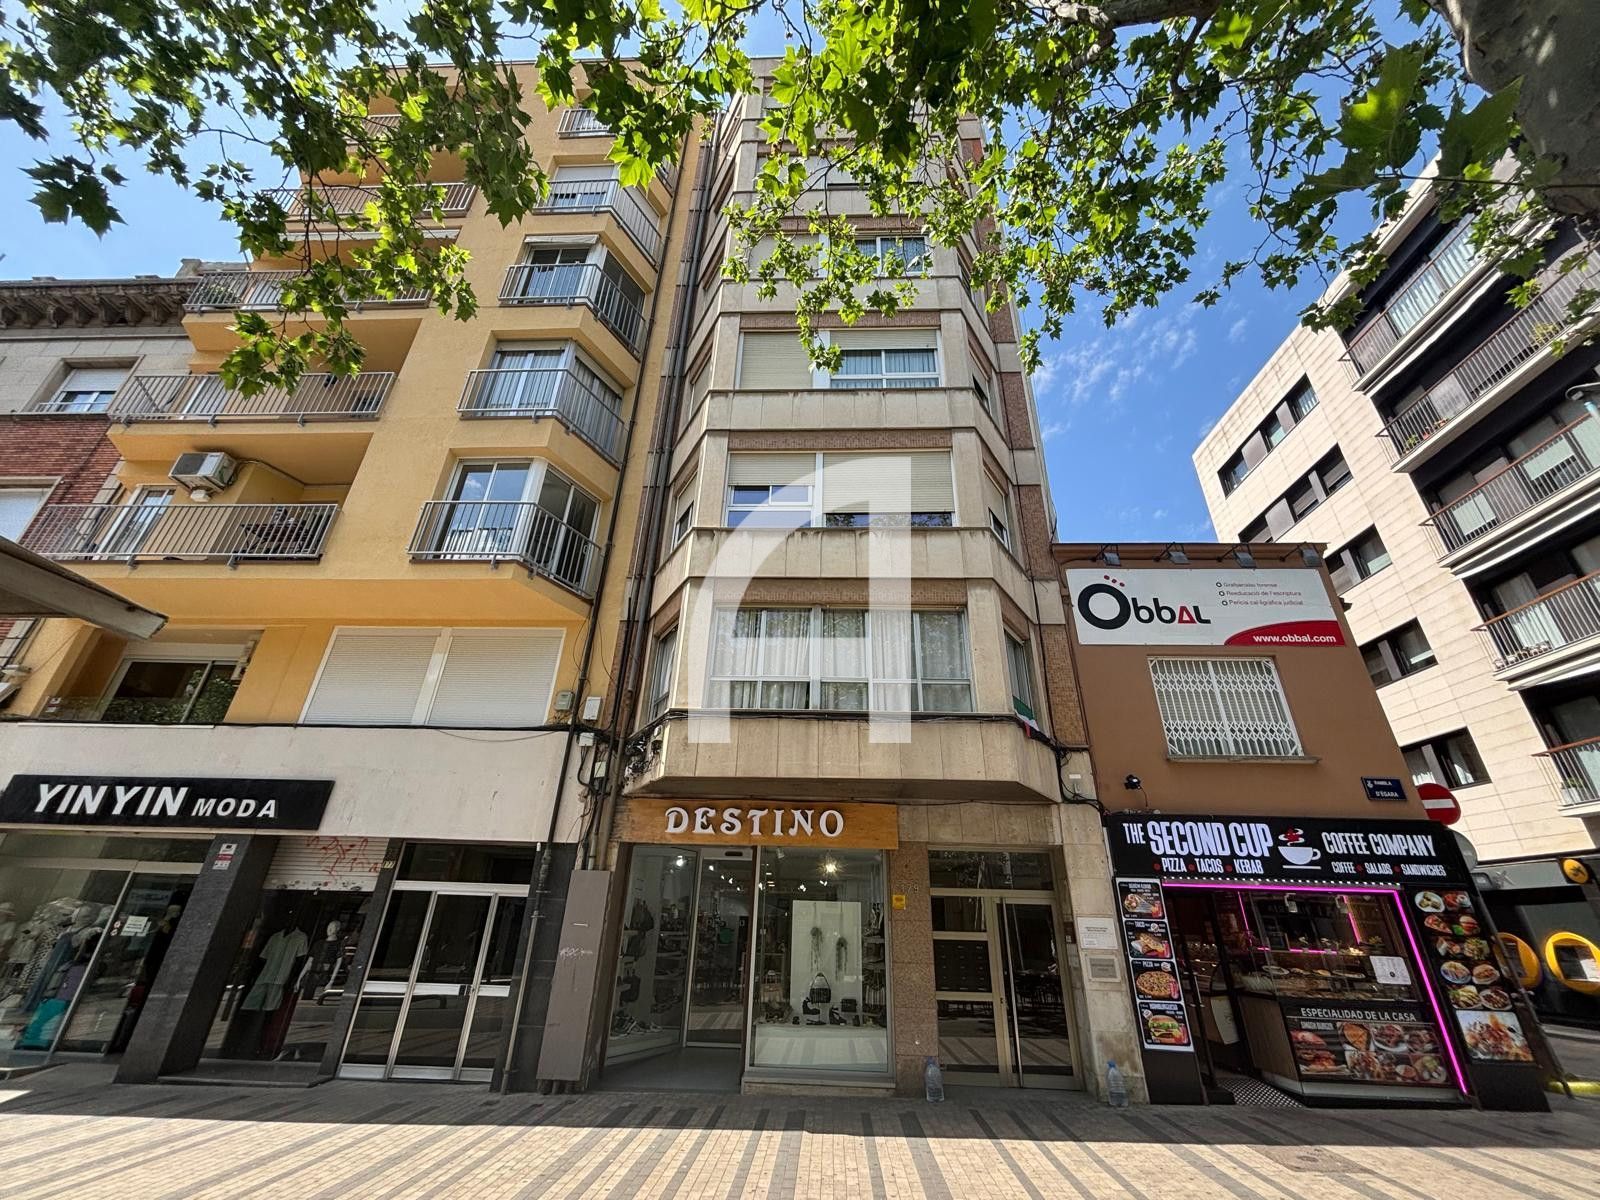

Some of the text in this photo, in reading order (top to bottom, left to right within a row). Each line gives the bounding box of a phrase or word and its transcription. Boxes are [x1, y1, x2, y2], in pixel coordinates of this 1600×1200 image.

[1253, 634, 1336, 642] www.obbal.com
[191, 797, 276, 818] MODA
[664, 806, 844, 838] DESTINO
[1122, 821, 1273, 857] THE SECOND CUP
[1321, 832, 1436, 857] COFFEE COMPANY
[1161, 857, 1264, 874] PIZZA TACOS KEBAB
[1331, 861, 1447, 876] COFFEE SALADS SANDWICHES
[1300, 1007, 1417, 1021] ESPECIALIDAD DE LA CASA
